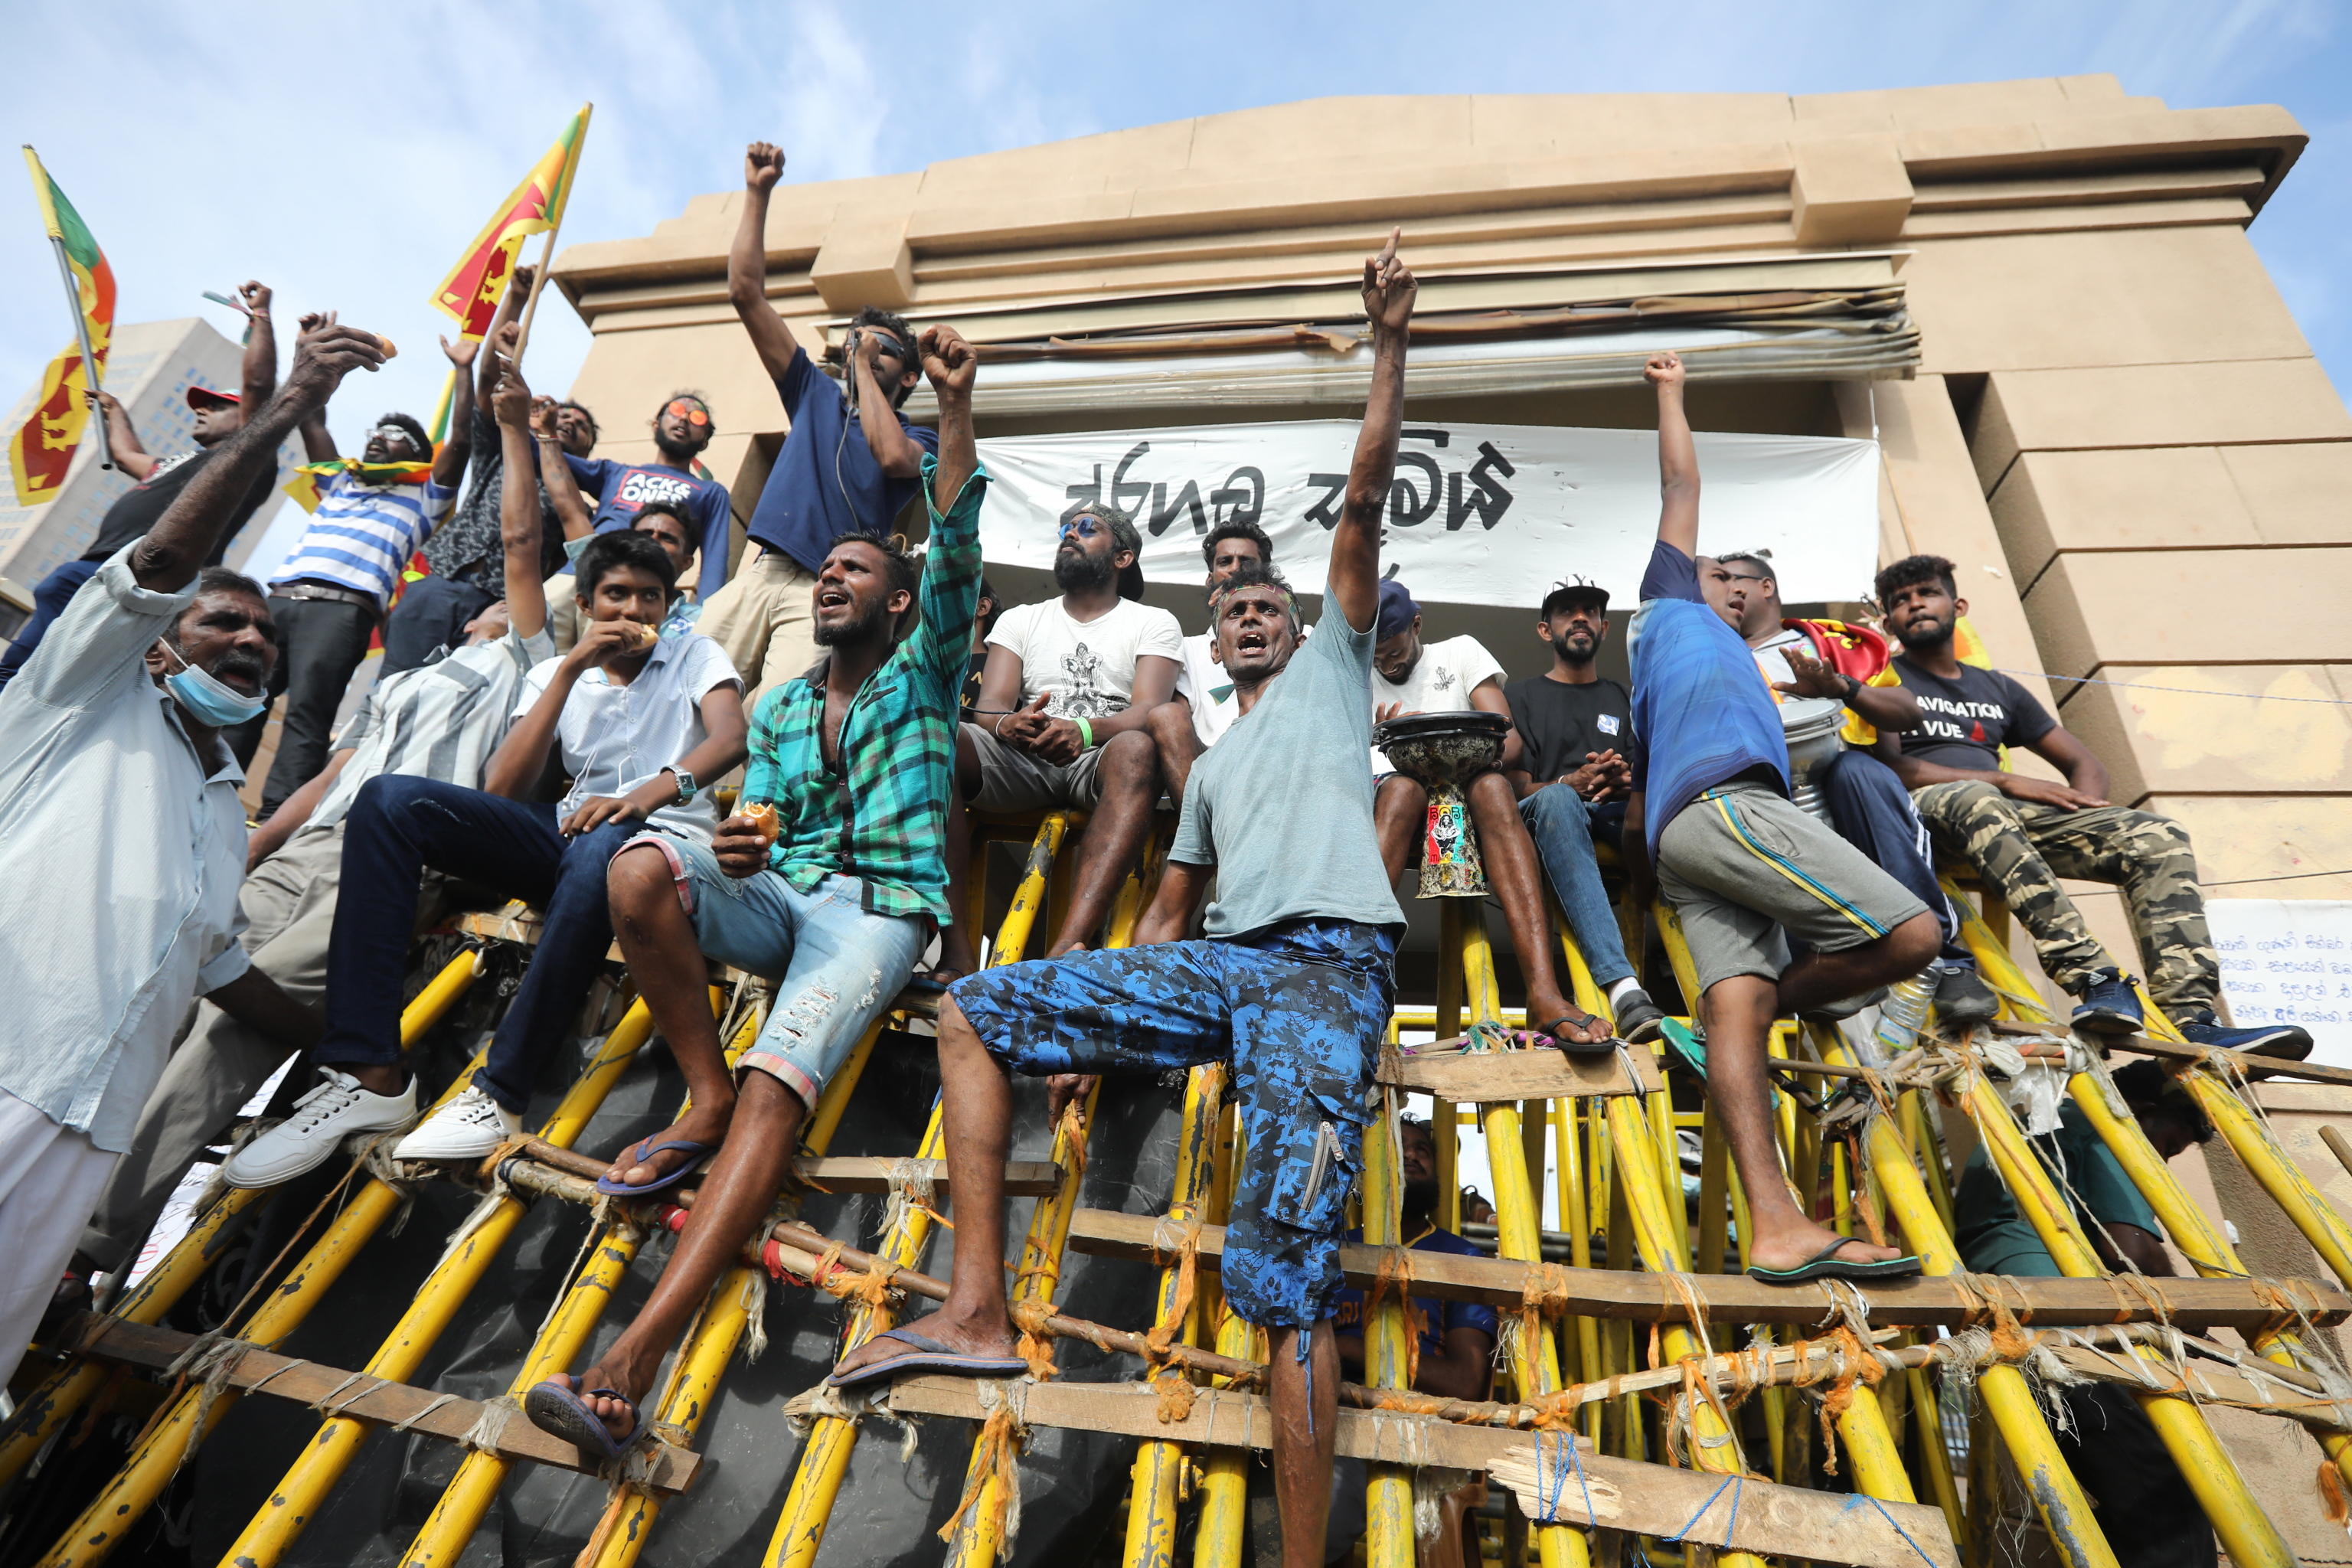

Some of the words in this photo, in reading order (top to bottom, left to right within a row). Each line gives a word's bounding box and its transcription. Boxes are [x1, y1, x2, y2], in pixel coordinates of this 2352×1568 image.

[1916, 695, 2004, 720] AVIGATION
[1922, 720, 1965, 738] VUE
[1429, 807, 1461, 821] BOB
